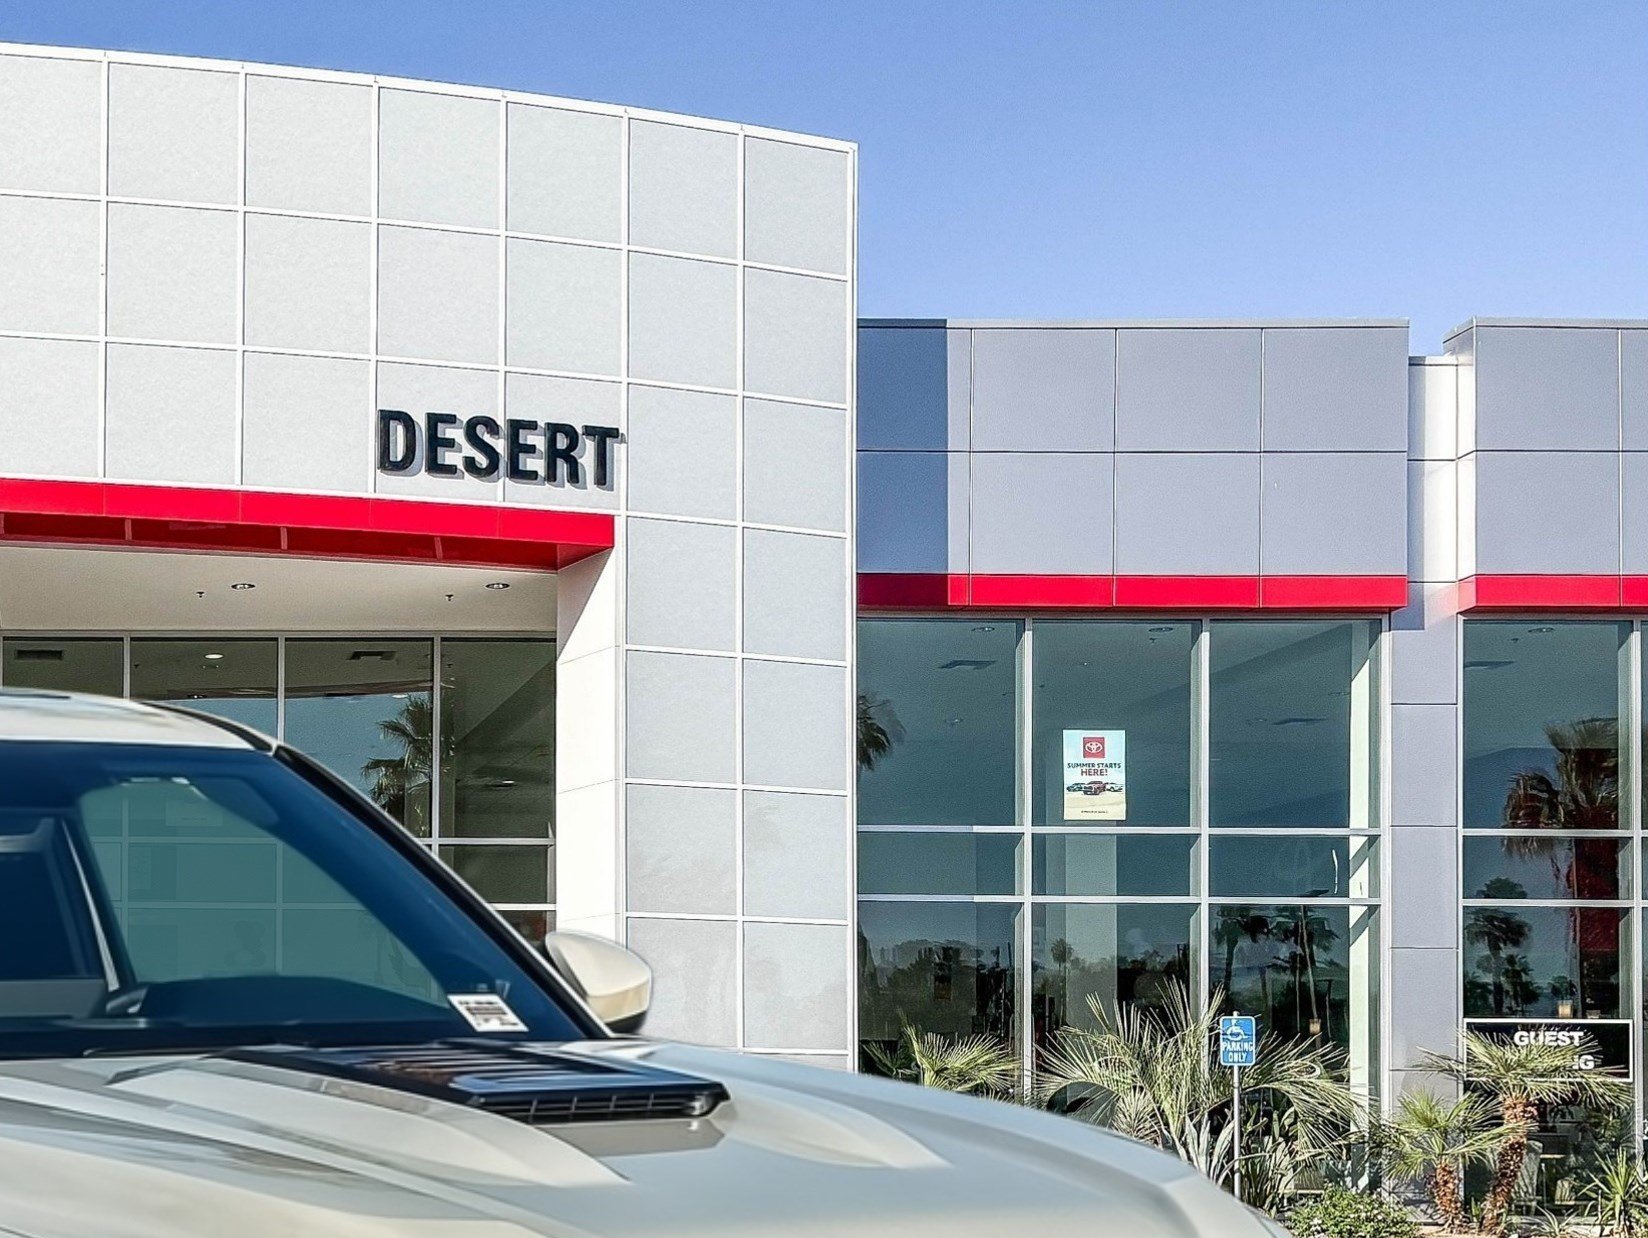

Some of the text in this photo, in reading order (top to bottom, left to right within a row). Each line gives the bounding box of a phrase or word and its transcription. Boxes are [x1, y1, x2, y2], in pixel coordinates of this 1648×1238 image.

[377, 409, 620, 487] DESERT
[1081, 768, 1108, 776] HERE!
[1513, 1030, 1584, 1046] GUEST
[1222, 1041, 1253, 1051] PARKING
[1228, 1052, 1247, 1062] ONLY
